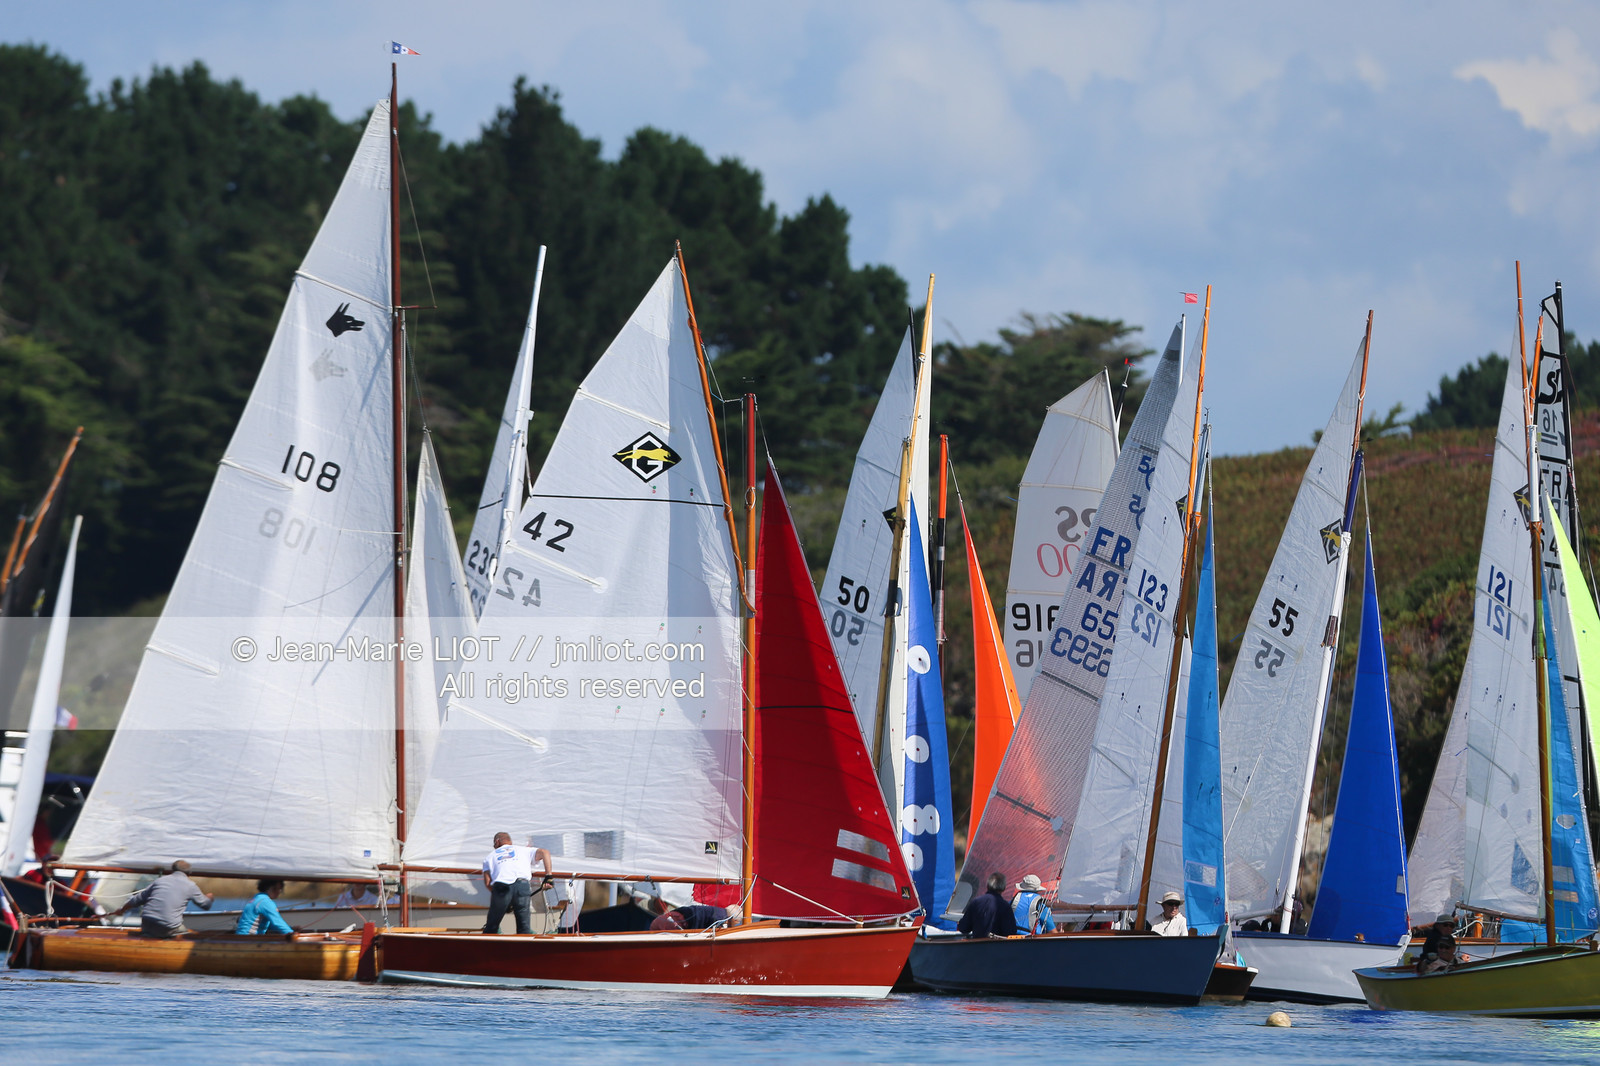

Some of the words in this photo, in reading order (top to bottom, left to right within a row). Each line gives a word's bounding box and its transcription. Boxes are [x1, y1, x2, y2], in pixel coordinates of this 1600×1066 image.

[281, 445, 341, 492] 108
[1539, 468, 1571, 499] FR
[522, 511, 574, 553] 42
[1091, 526, 1133, 570] FR
[837, 575, 870, 613] 50
[1138, 569, 1168, 612] 123
[1487, 565, 1513, 608] 121
[1081, 602, 1119, 643] 65
[1268, 597, 1299, 637] 55
